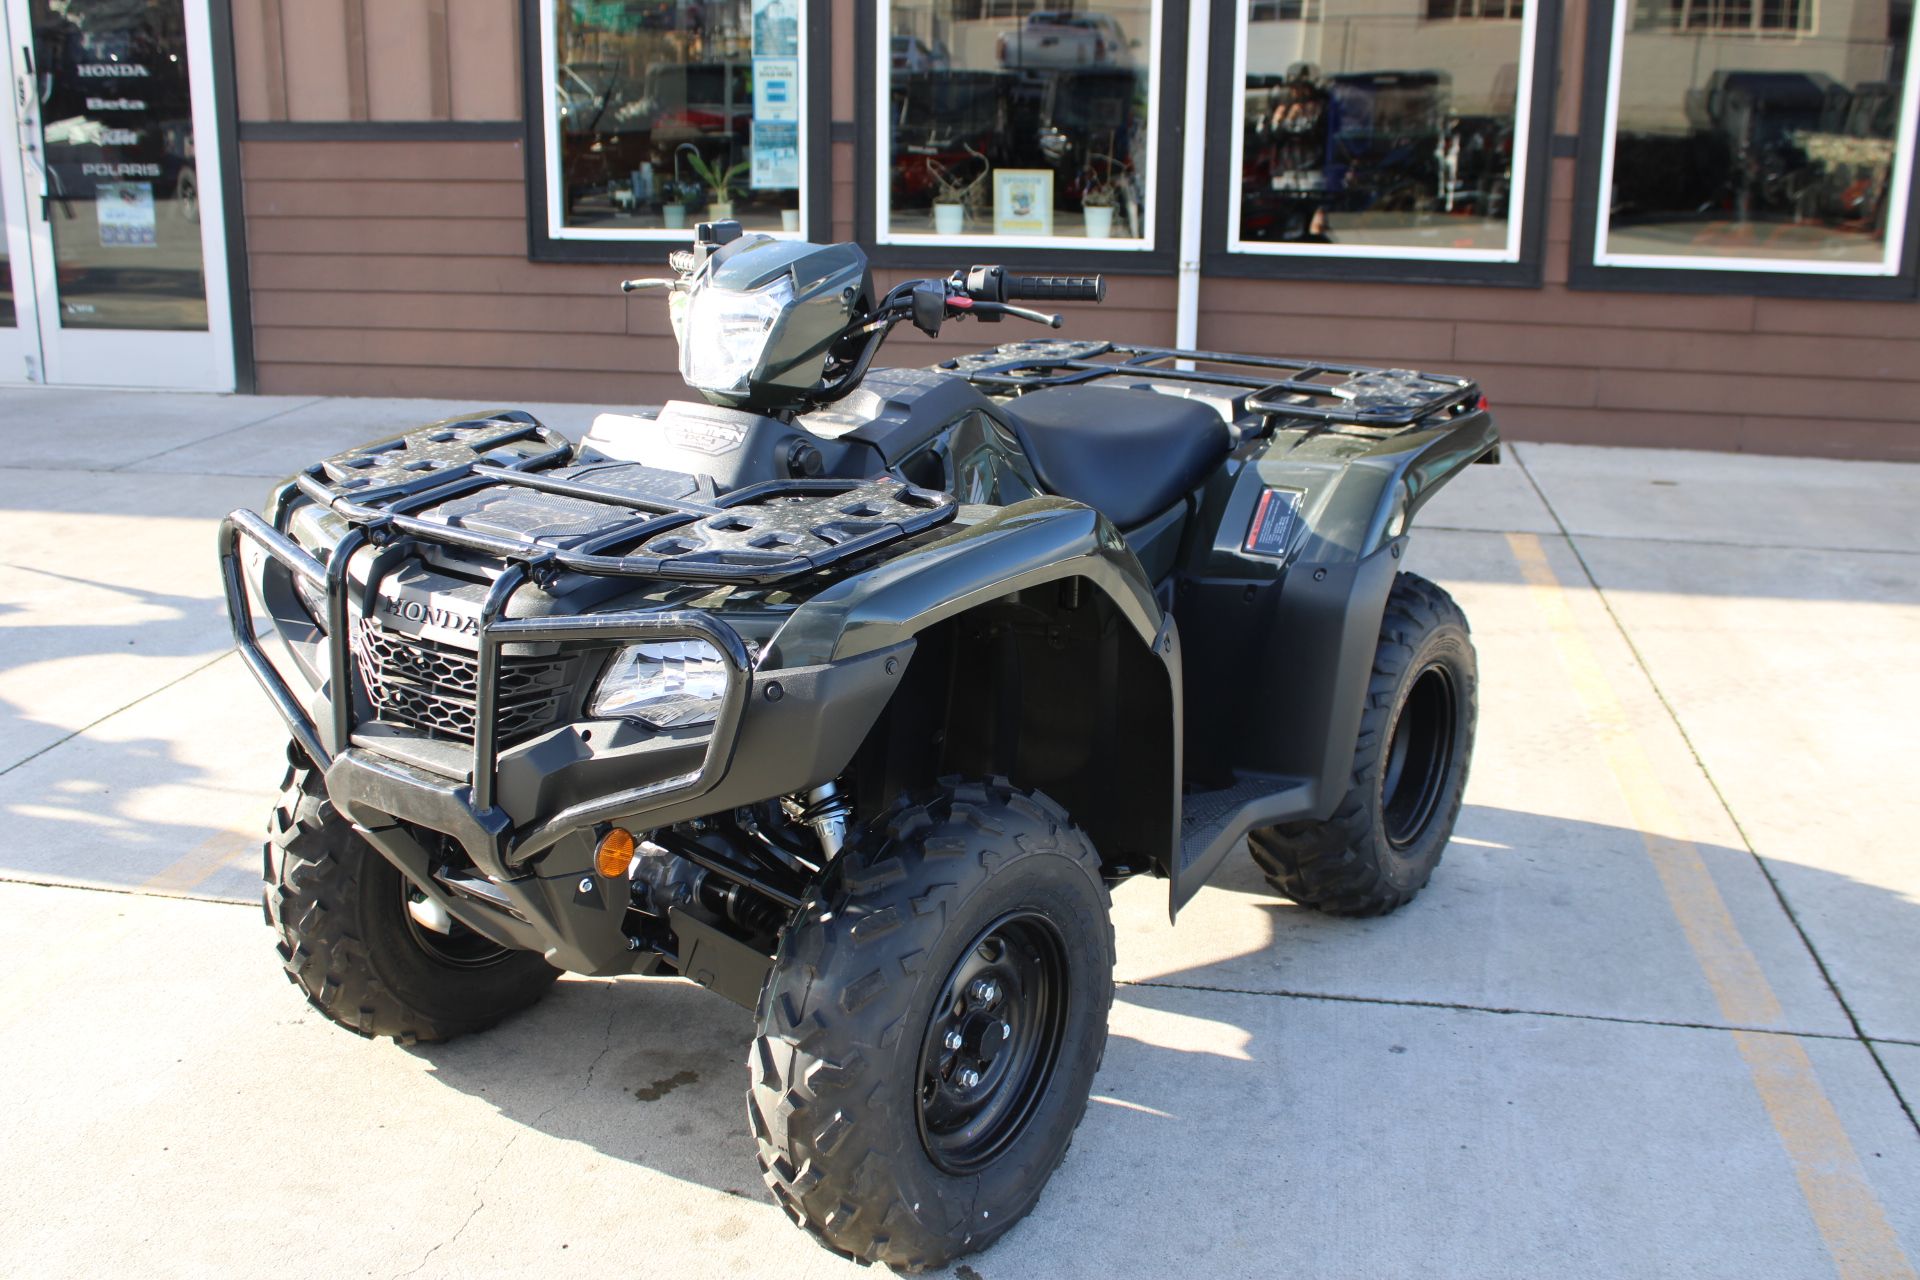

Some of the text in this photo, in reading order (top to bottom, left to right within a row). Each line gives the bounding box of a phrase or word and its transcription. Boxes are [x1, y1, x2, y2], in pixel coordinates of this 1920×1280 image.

[77, 64, 148, 76] HONDA
[86, 98, 145, 110] Beta
[82, 163, 160, 176] POLARIS
[383, 595, 479, 637] HONDA
